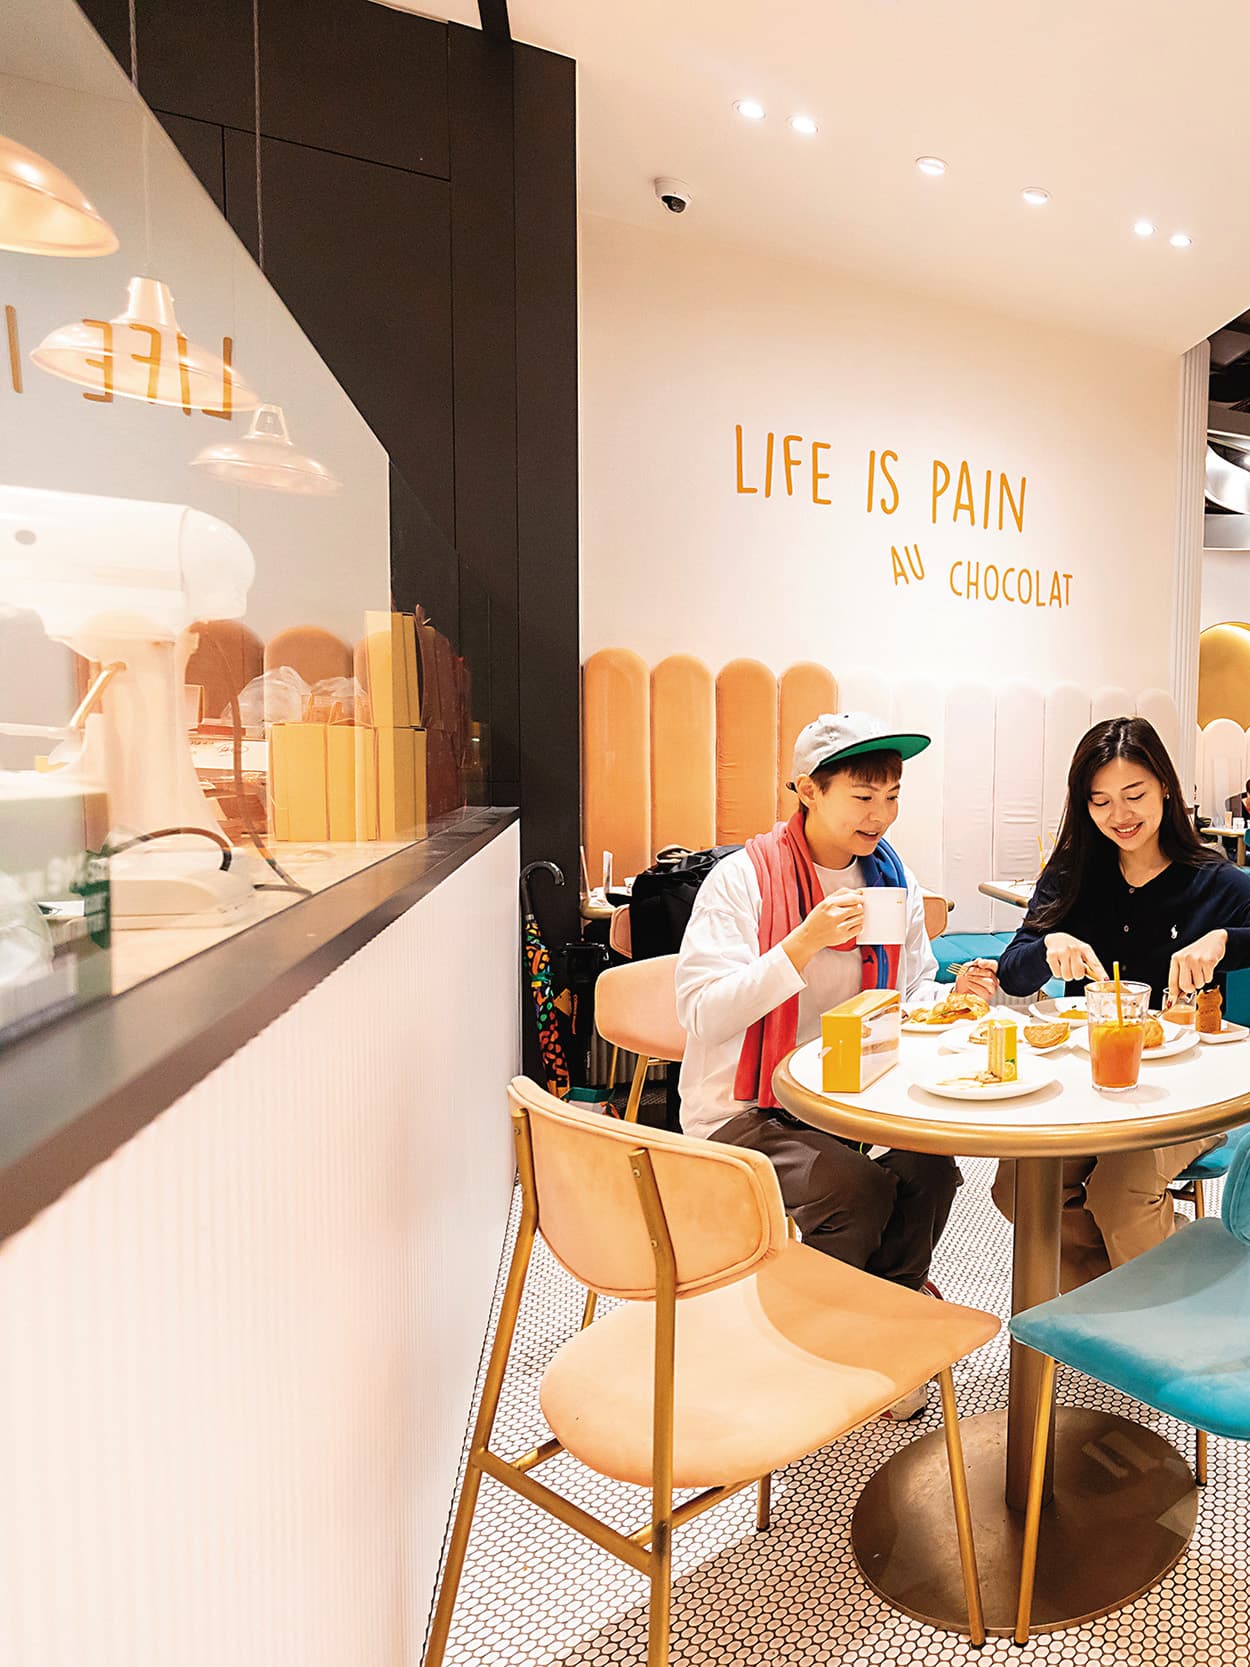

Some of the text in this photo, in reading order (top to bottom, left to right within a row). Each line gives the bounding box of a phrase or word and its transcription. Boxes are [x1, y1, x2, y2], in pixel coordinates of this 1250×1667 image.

[735, 424, 1027, 533] LIFE IS PAIN
[890, 543, 1073, 609] AU CHOCOLAT
